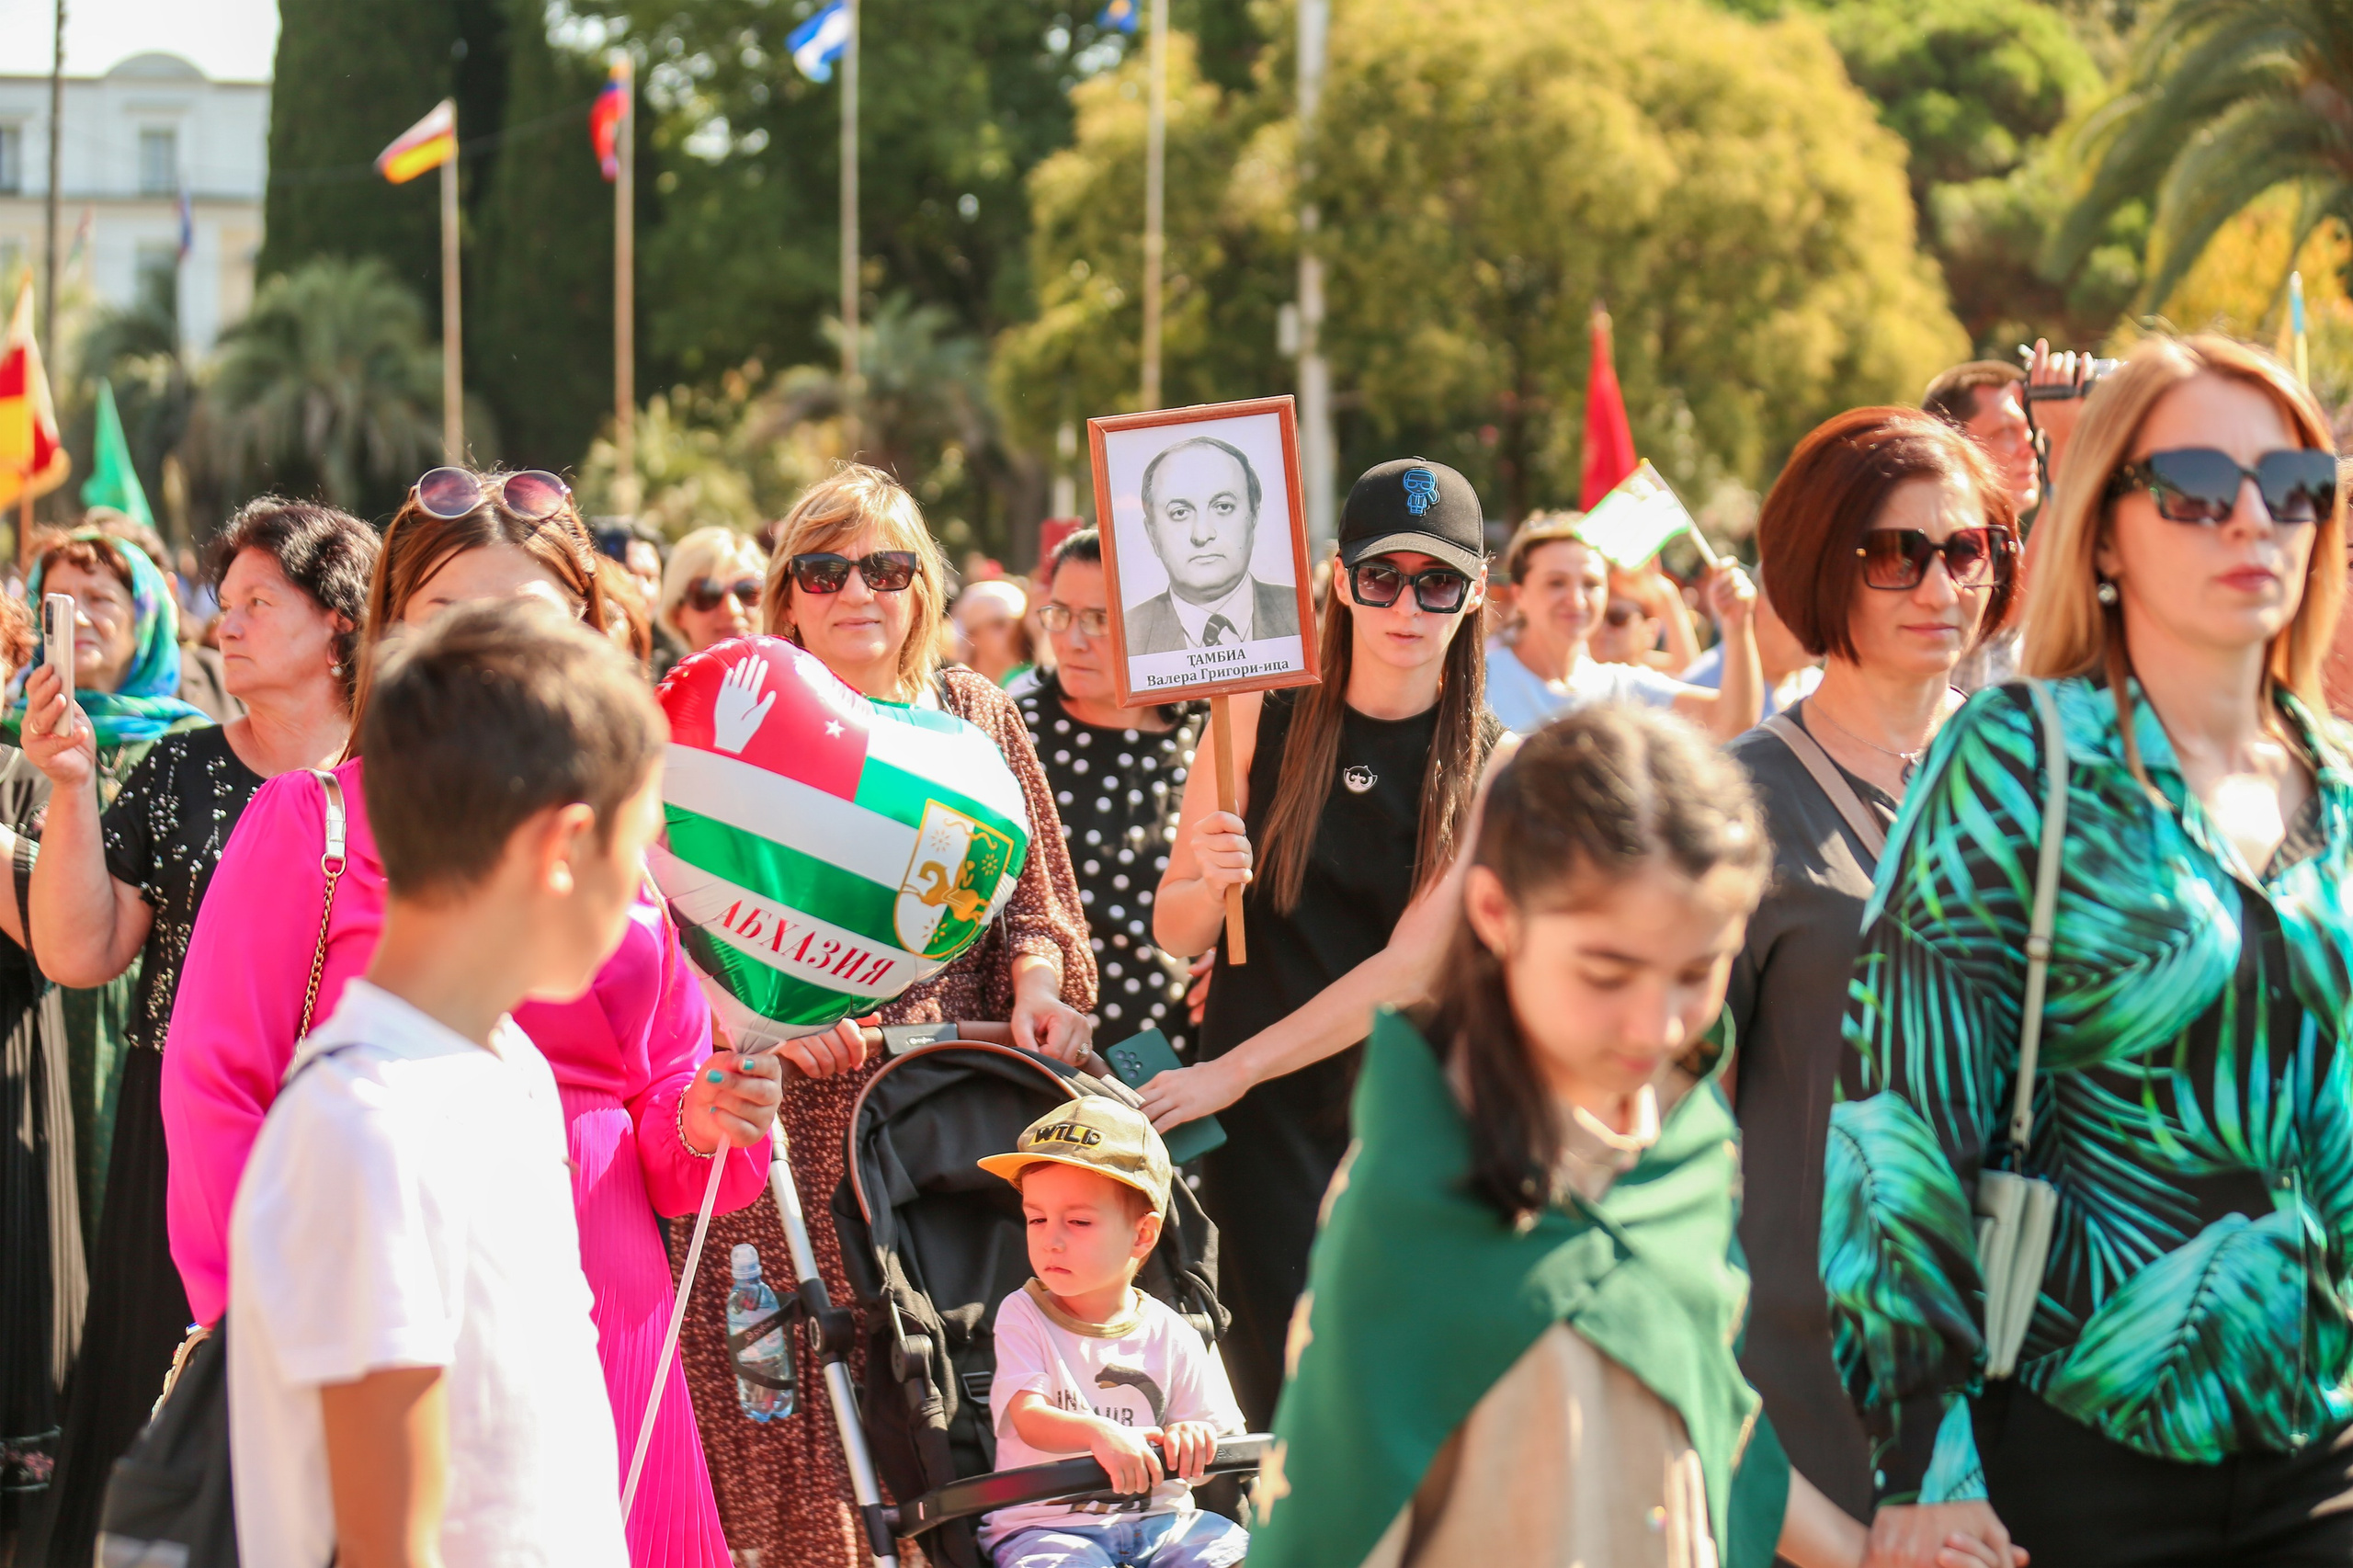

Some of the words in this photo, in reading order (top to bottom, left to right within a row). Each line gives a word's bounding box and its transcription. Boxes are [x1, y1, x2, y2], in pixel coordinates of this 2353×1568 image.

[1147, 673, 1197, 686] Валера
[710, 899, 896, 986] АБХАЗИЯ
[1035, 1124, 1101, 1145] WILD
